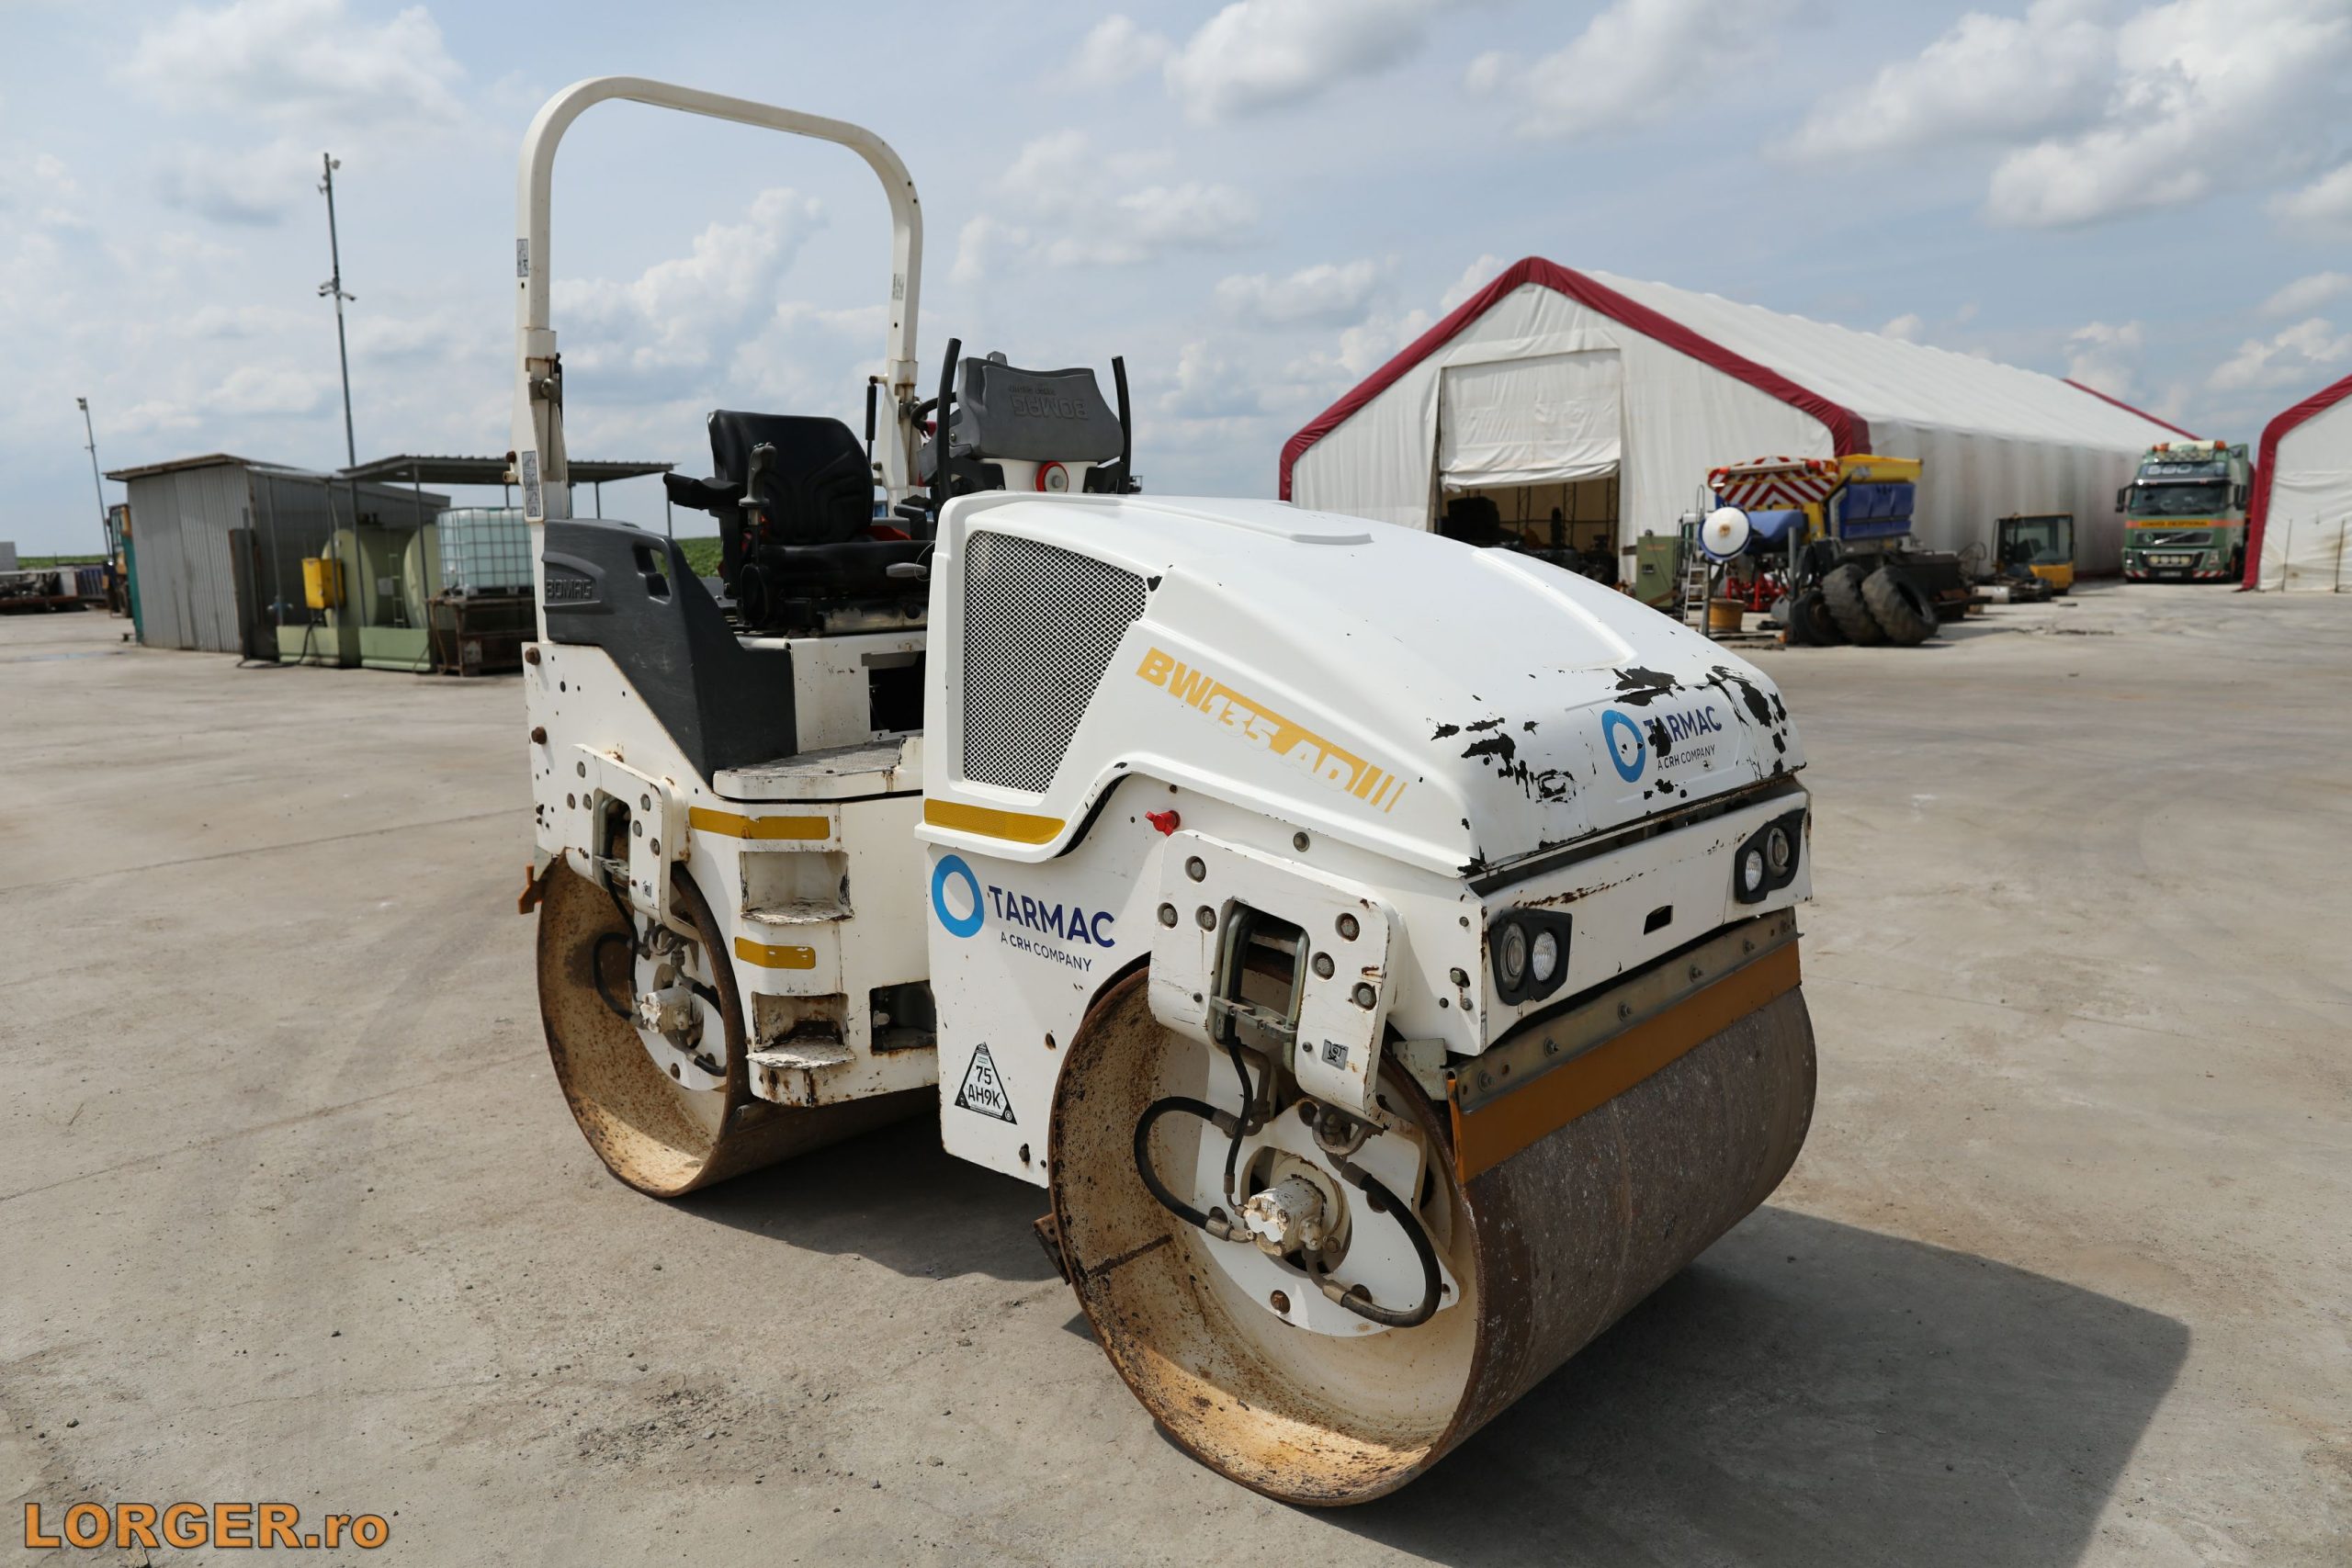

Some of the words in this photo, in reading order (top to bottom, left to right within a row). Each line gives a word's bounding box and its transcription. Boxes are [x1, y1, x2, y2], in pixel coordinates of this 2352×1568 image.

[546, 579, 594, 599] BOMAG
[1657, 759, 1664, 772] A
[1664, 754, 1680, 769] CRH
[1680, 743, 1715, 764] COMPANY
[988, 885, 1116, 949] TARMAC
[1001, 931, 1009, 945] A
[1010, 934, 1032, 953] CRH
[1033, 942, 1092, 973] COMPANY
[976, 1065, 992, 1086] 75
[967, 1083, 1001, 1110] AH9K
